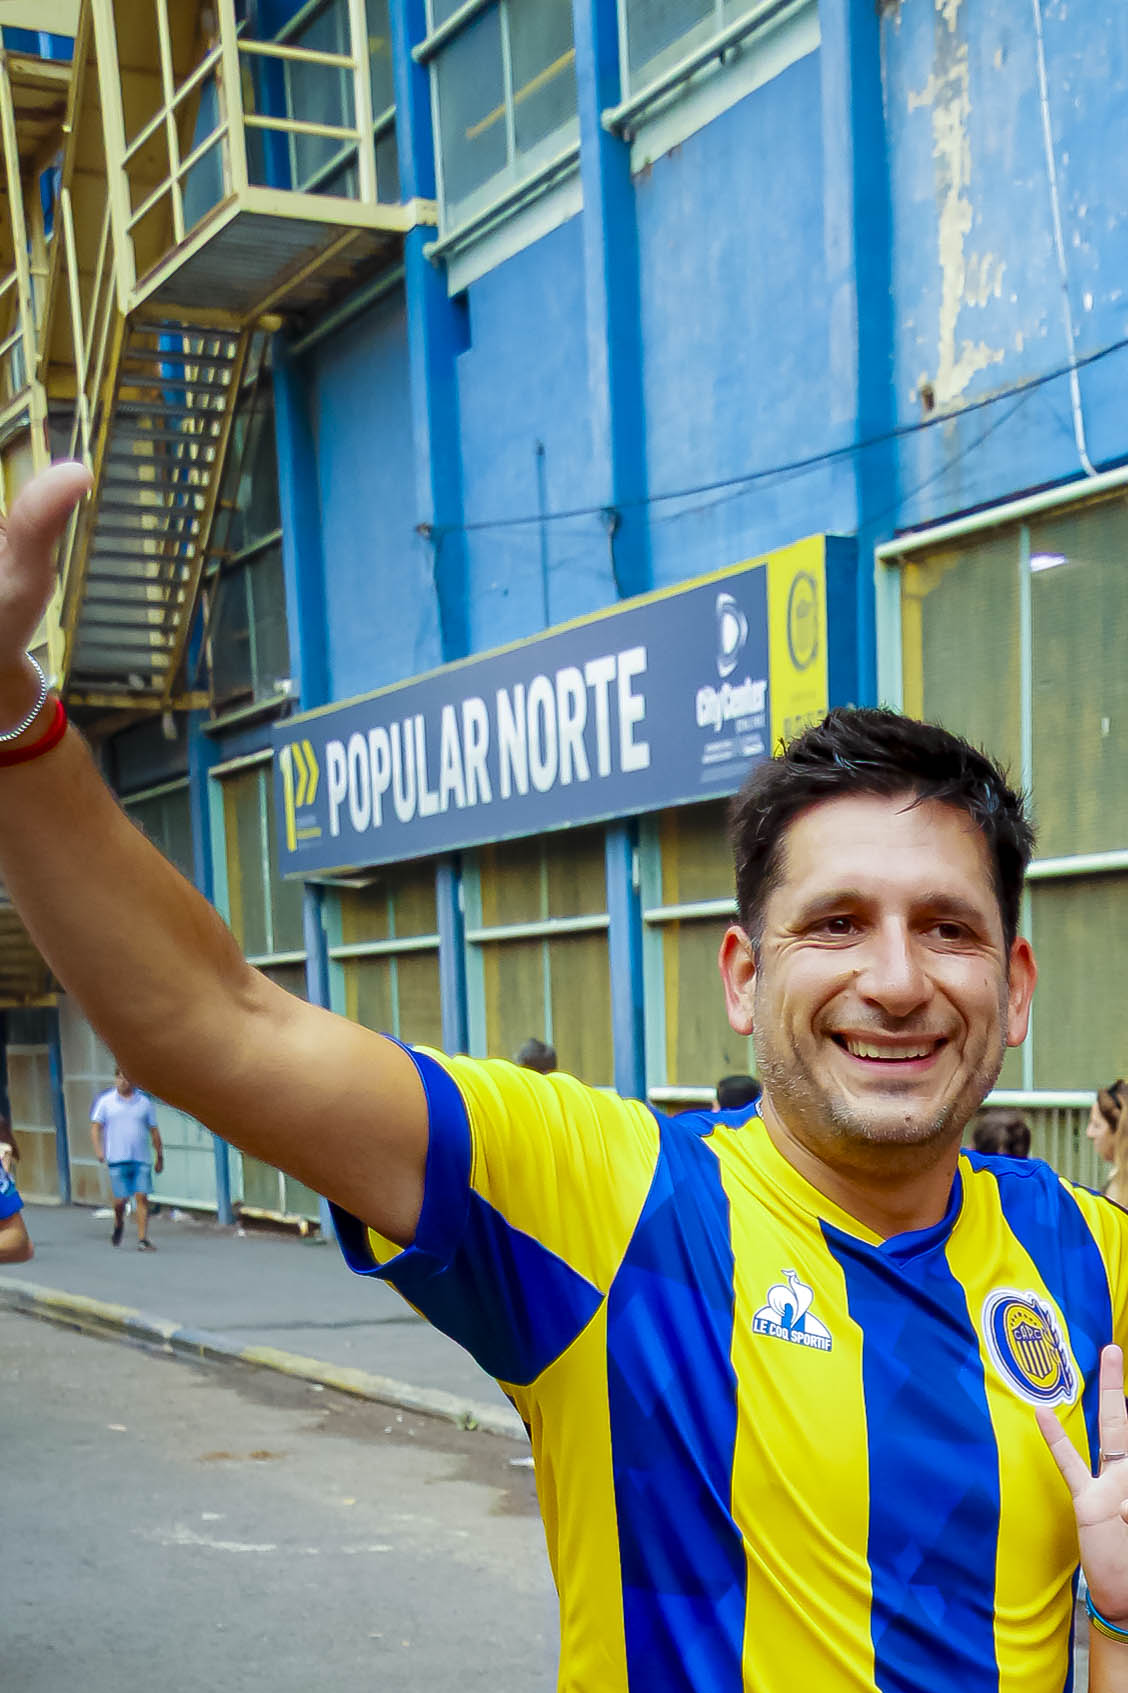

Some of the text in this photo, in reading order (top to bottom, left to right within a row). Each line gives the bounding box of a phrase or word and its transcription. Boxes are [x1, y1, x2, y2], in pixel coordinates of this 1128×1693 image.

[325, 645, 651, 837] POPULAR NORTE
[753, 1318, 832, 1351] LE COQ SPORTIF
